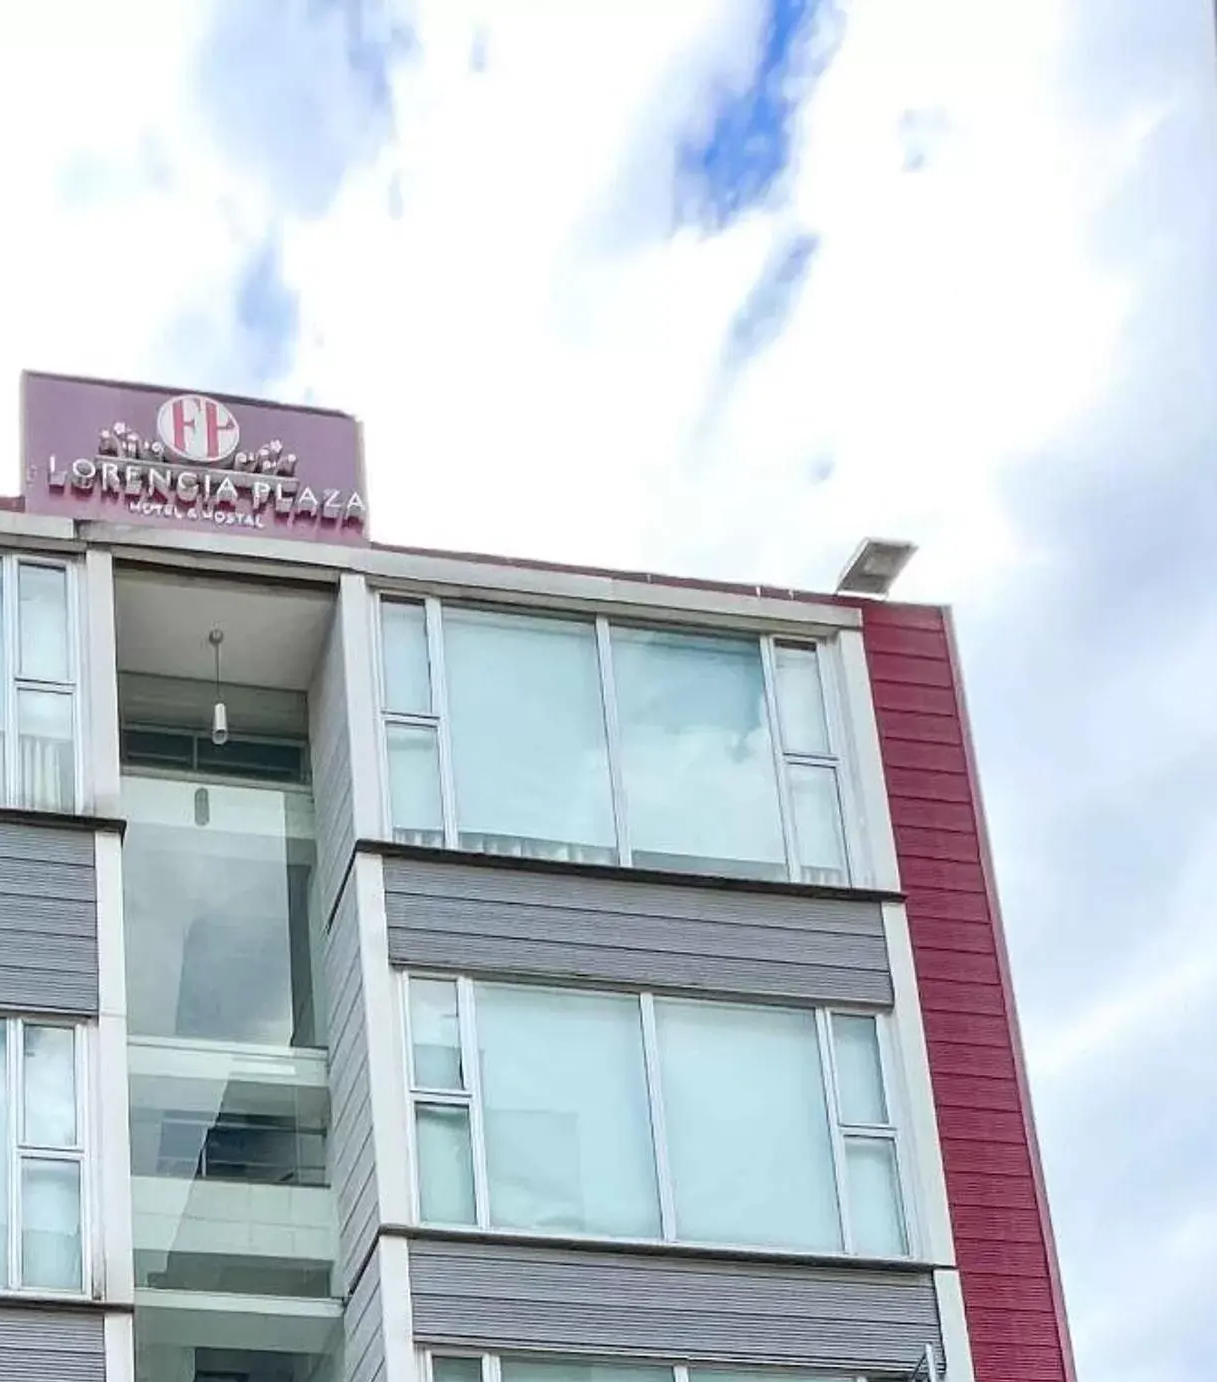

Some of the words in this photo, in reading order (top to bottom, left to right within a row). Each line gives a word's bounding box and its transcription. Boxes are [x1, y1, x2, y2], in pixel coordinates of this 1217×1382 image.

[129, 500, 181, 519] HOTEL
[187, 508, 197, 518] &
[252, 480, 364, 520] PLAZA
